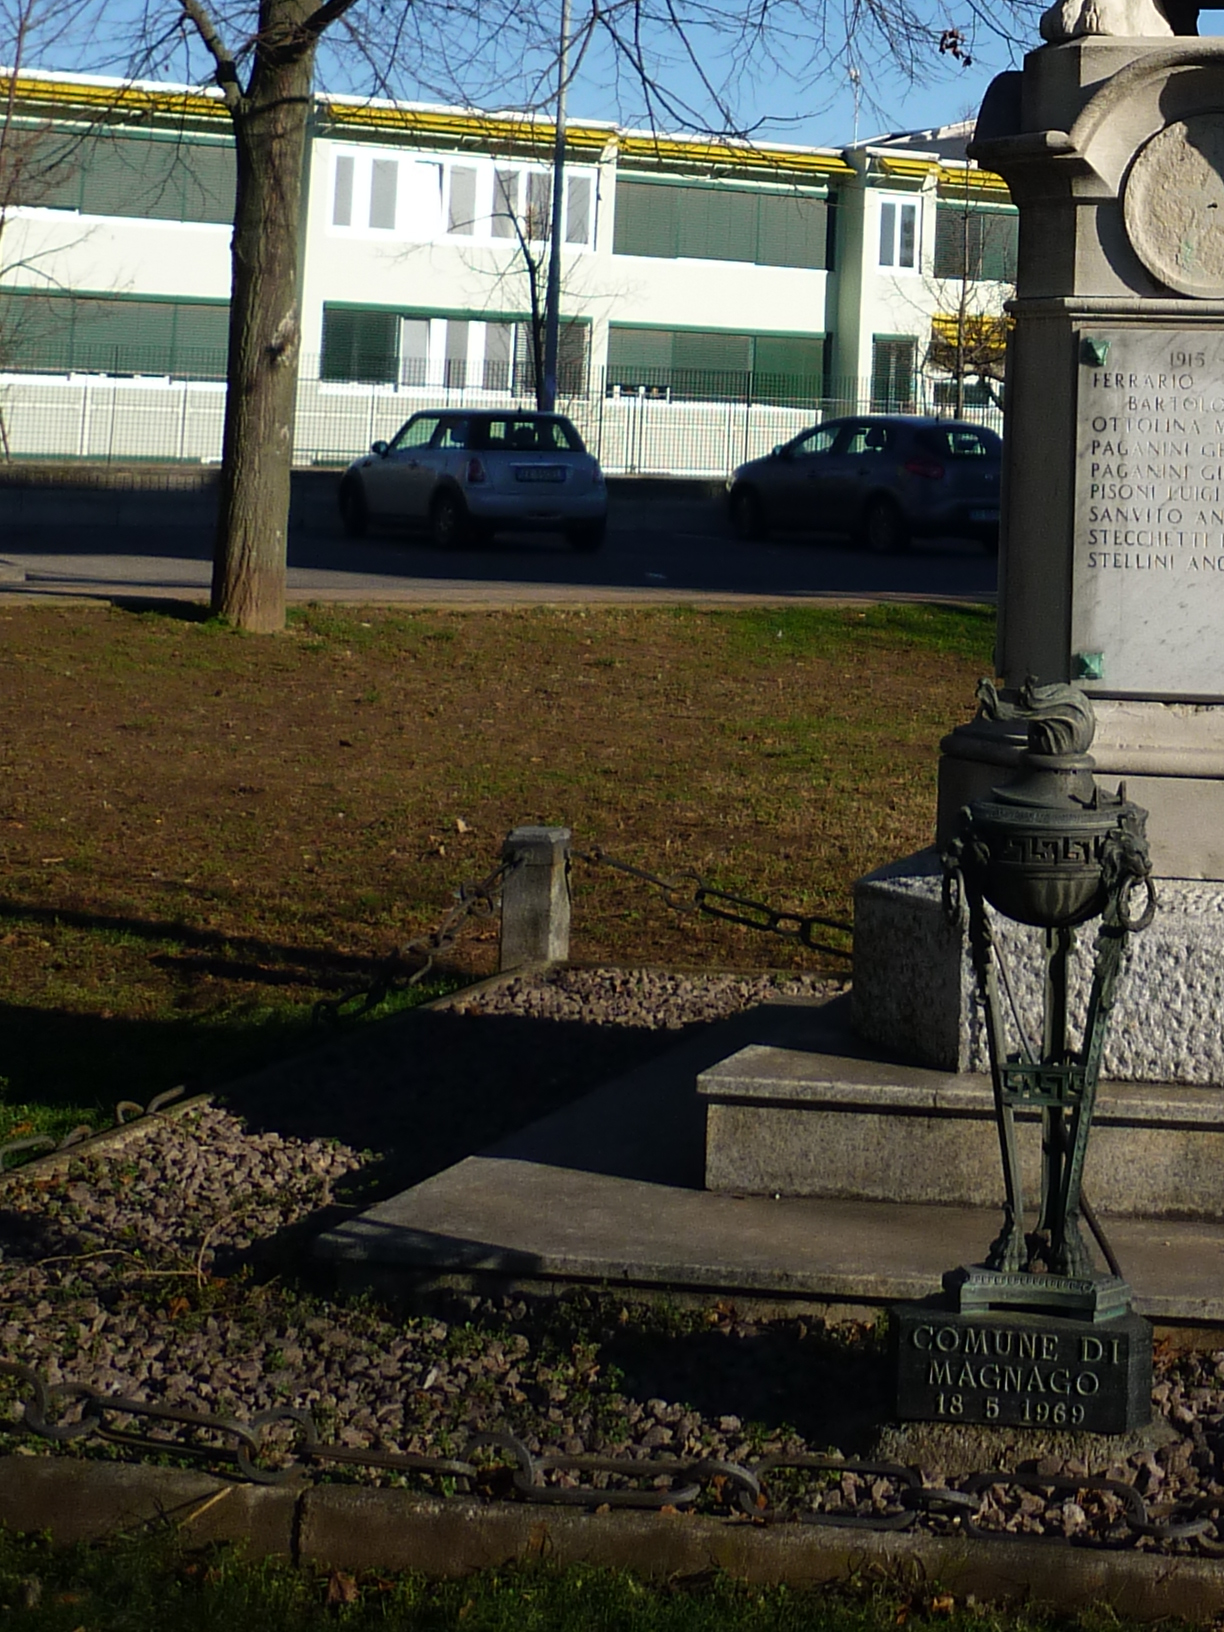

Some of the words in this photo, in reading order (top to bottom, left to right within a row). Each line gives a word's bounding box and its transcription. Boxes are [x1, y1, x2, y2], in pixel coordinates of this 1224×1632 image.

[1170, 352, 1205, 367] 1915
[1092, 372, 1194, 389] FERRARIO
[1092, 416, 1200, 435] OTTOLINA
[1091, 440, 1189, 457] PAGANINI
[1091, 462, 1188, 480] PAGANINI
[1090, 483, 1155, 500] PISONI
[1167, 485, 1219, 502] LUIGI
[1089, 506, 1183, 524] SANVITO
[1088, 528, 1208, 549] STECCHETTI
[1087, 551, 1174, 570] STELLINI
[912, 1324, 1059, 1362] COMUNE
[1080, 1336, 1120, 1365] DI
[927, 1359, 1100, 1396] MAGNAGO
[935, 1392, 964, 1416] 18
[986, 1395, 1000, 1419] 5
[1020, 1398, 1085, 1425] 1969
